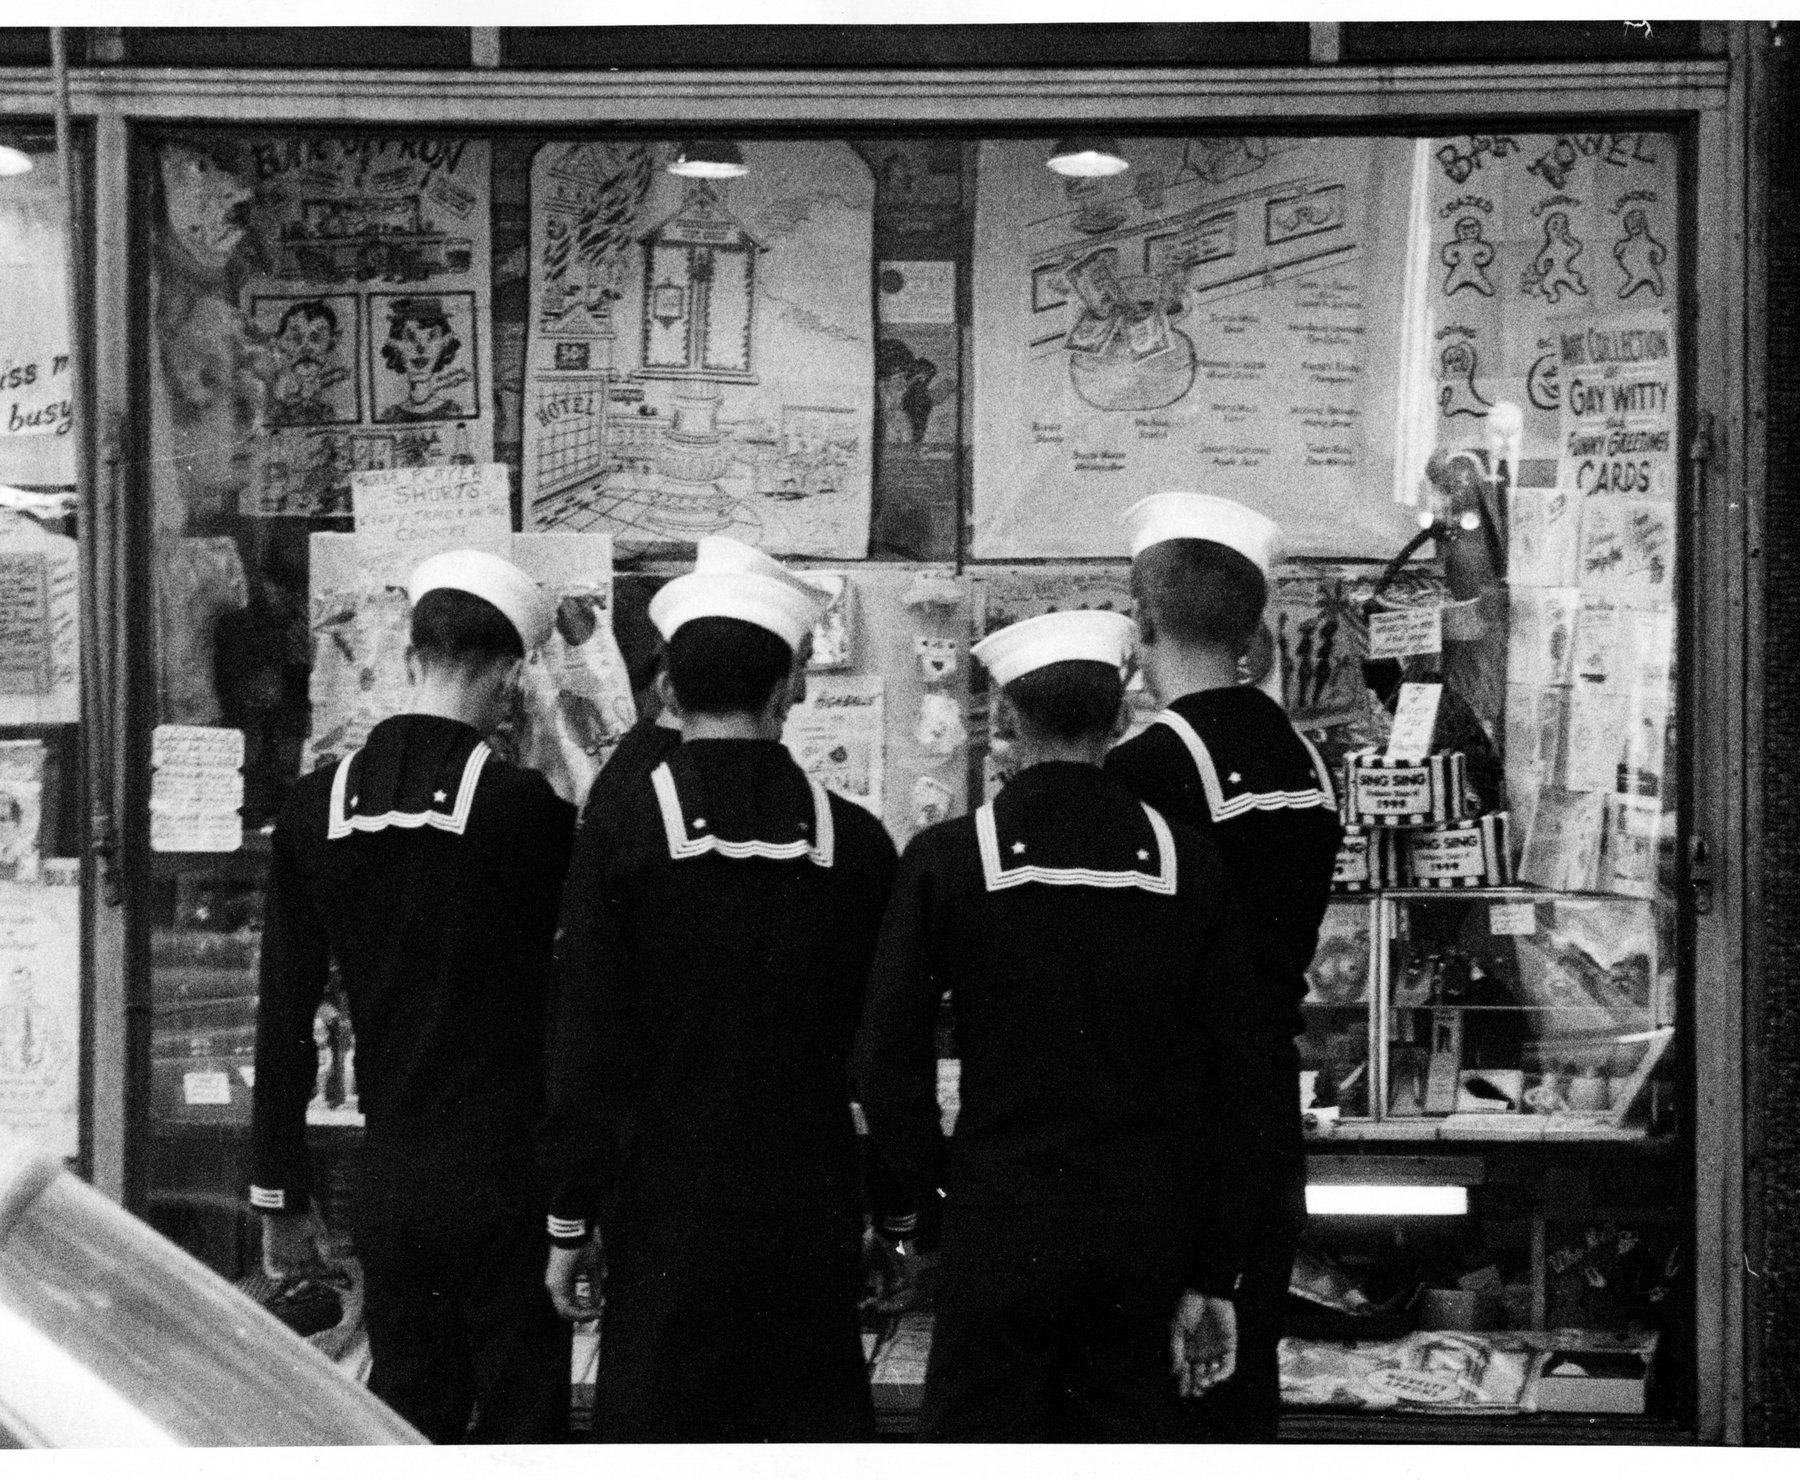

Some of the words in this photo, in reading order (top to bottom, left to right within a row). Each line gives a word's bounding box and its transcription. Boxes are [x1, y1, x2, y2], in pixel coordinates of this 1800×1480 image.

[534, 395, 596, 428] HOTEL
[1569, 378, 1606, 416] GAY
[1611, 381, 1669, 413] WITTY
[7, 399, 75, 437] busy
[393, 479, 482, 505] SHORTS
[1576, 459, 1651, 497] CARDS
[1360, 774, 1389, 787] SING
[1392, 772, 1426, 787] SING
[1443, 834, 1478, 849] SING
